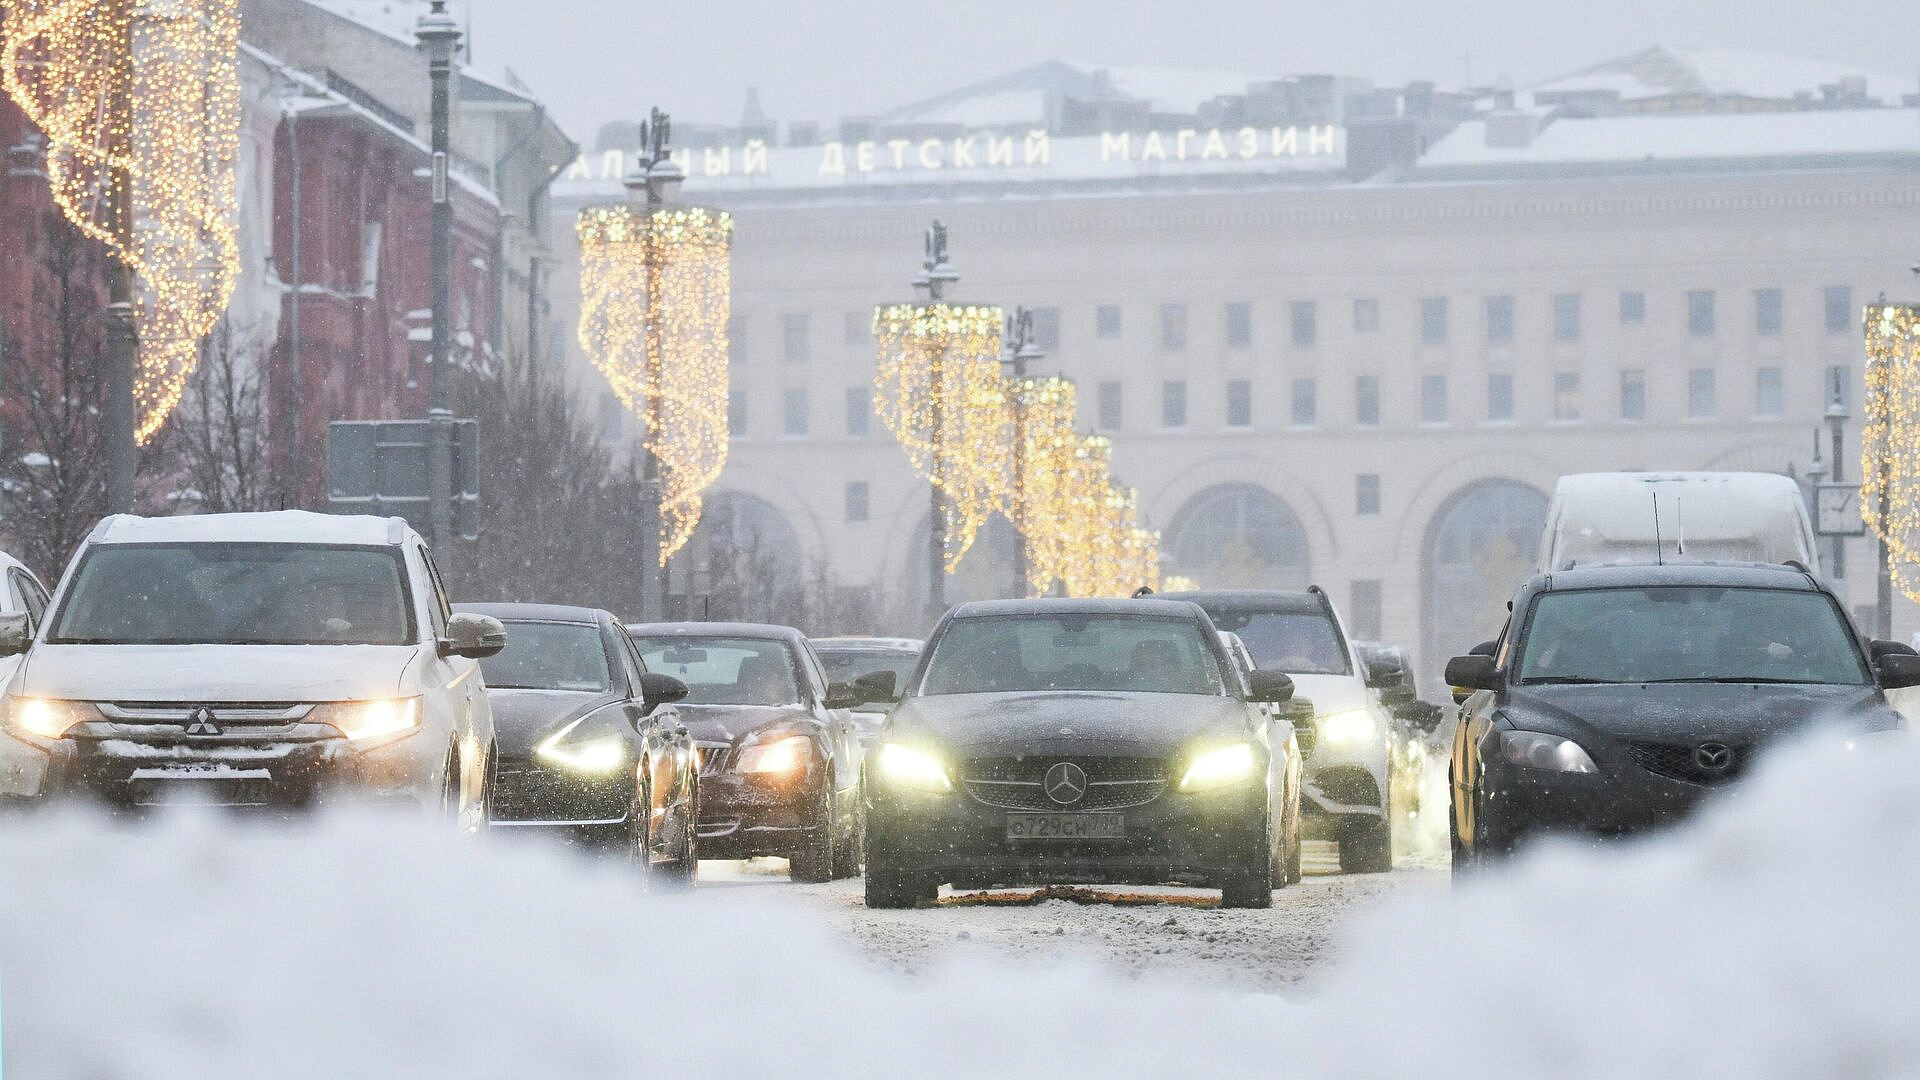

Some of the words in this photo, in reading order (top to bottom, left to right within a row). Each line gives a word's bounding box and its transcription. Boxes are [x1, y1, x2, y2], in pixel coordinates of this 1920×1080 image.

[550, 139, 768, 180] АЛНЫЙ
[819, 129, 1051, 176] ДЕТСКИЙ
[1100, 124, 1335, 162] МАГАЗИН
